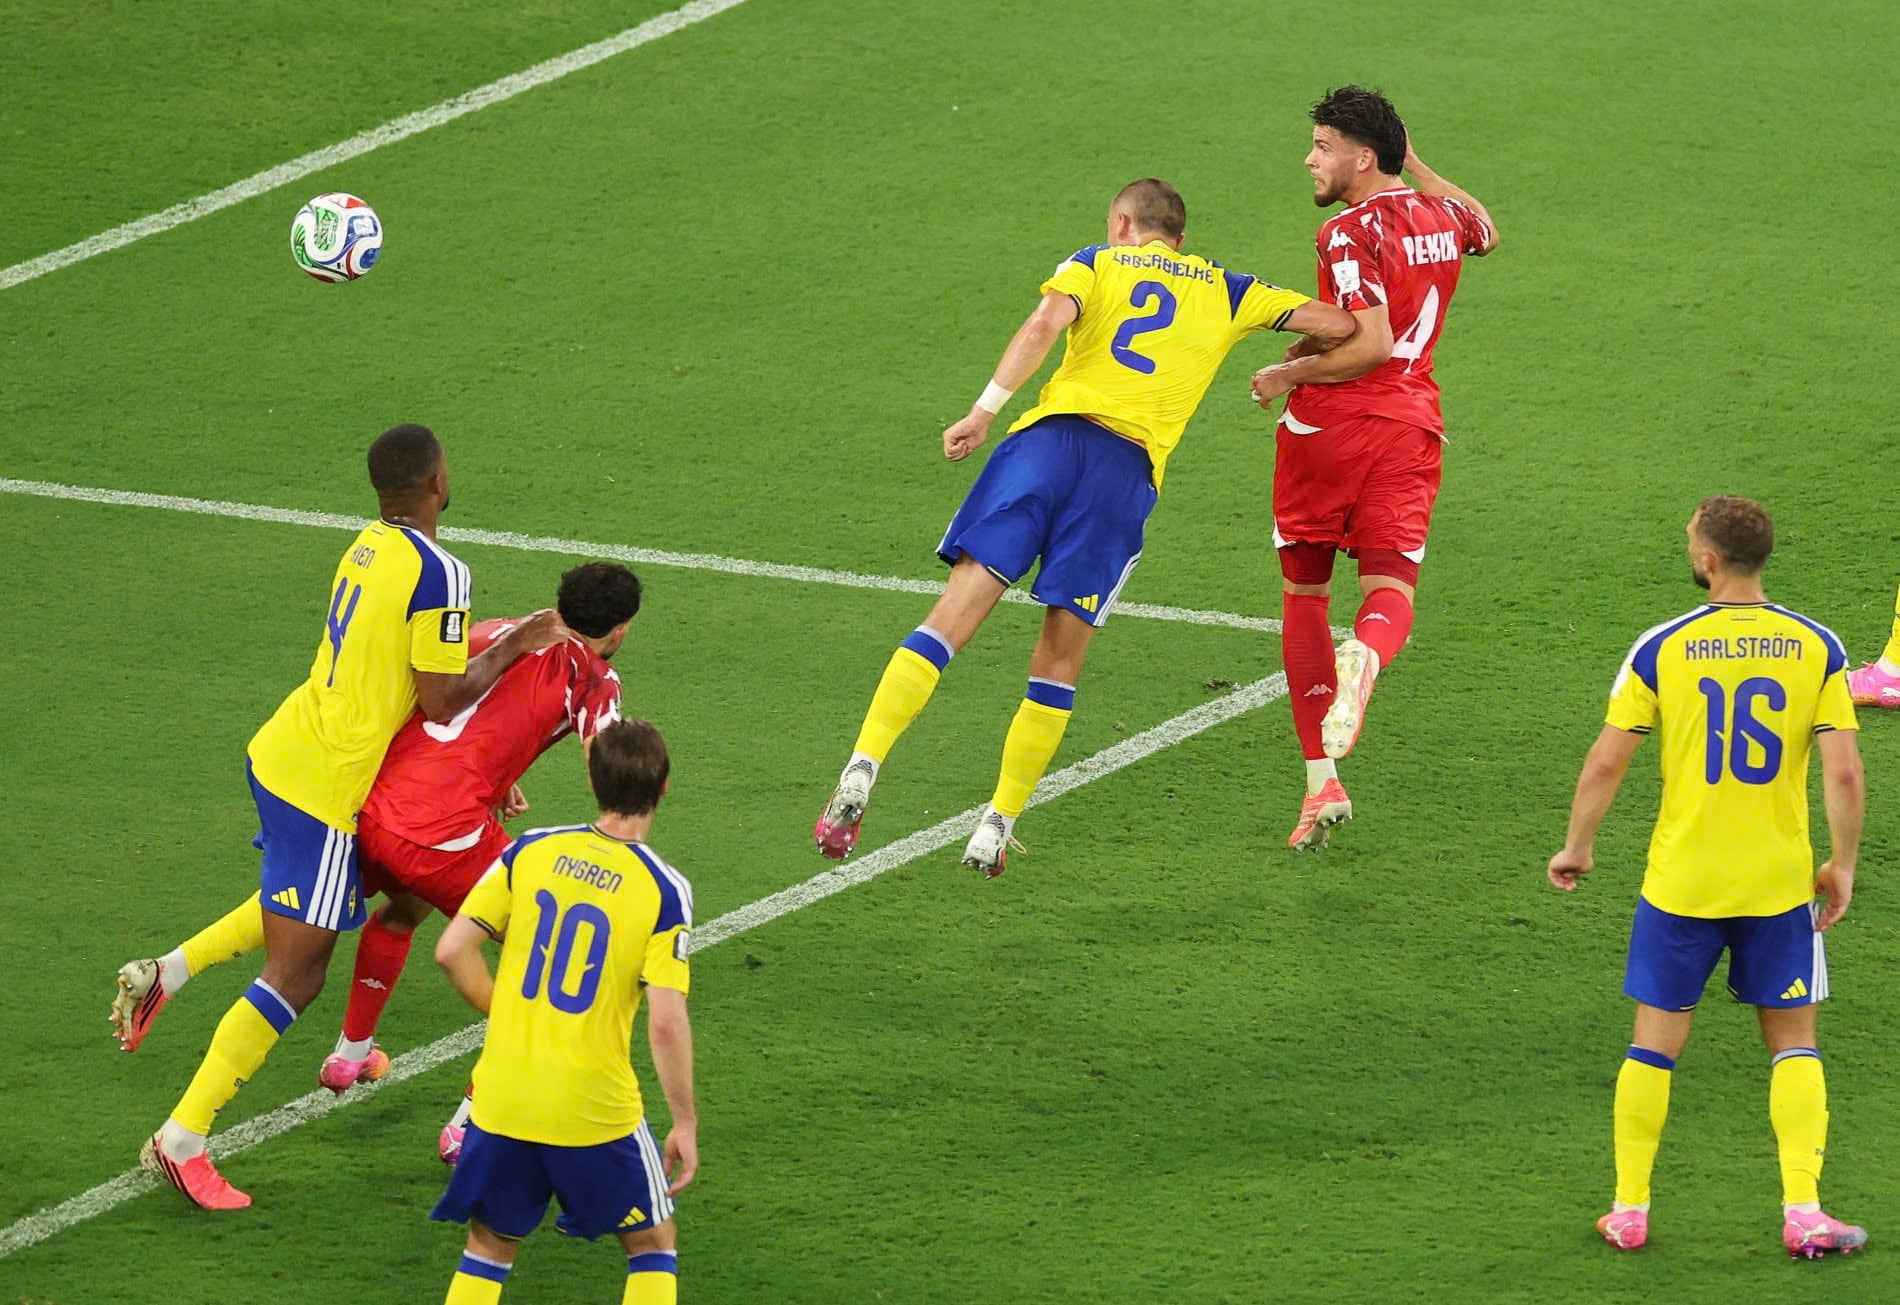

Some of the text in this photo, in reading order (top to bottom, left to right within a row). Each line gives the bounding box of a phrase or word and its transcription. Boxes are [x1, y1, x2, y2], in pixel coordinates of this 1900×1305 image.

[1111, 280, 1177, 374] 2
[1391, 284, 1440, 375] 4
[327, 576, 362, 688] 4
[1685, 632, 1802, 661] KARLSTRÖM
[1697, 677, 1787, 786] 16
[552, 855, 623, 894] NYGREN
[521, 889, 611, 1014] 10
